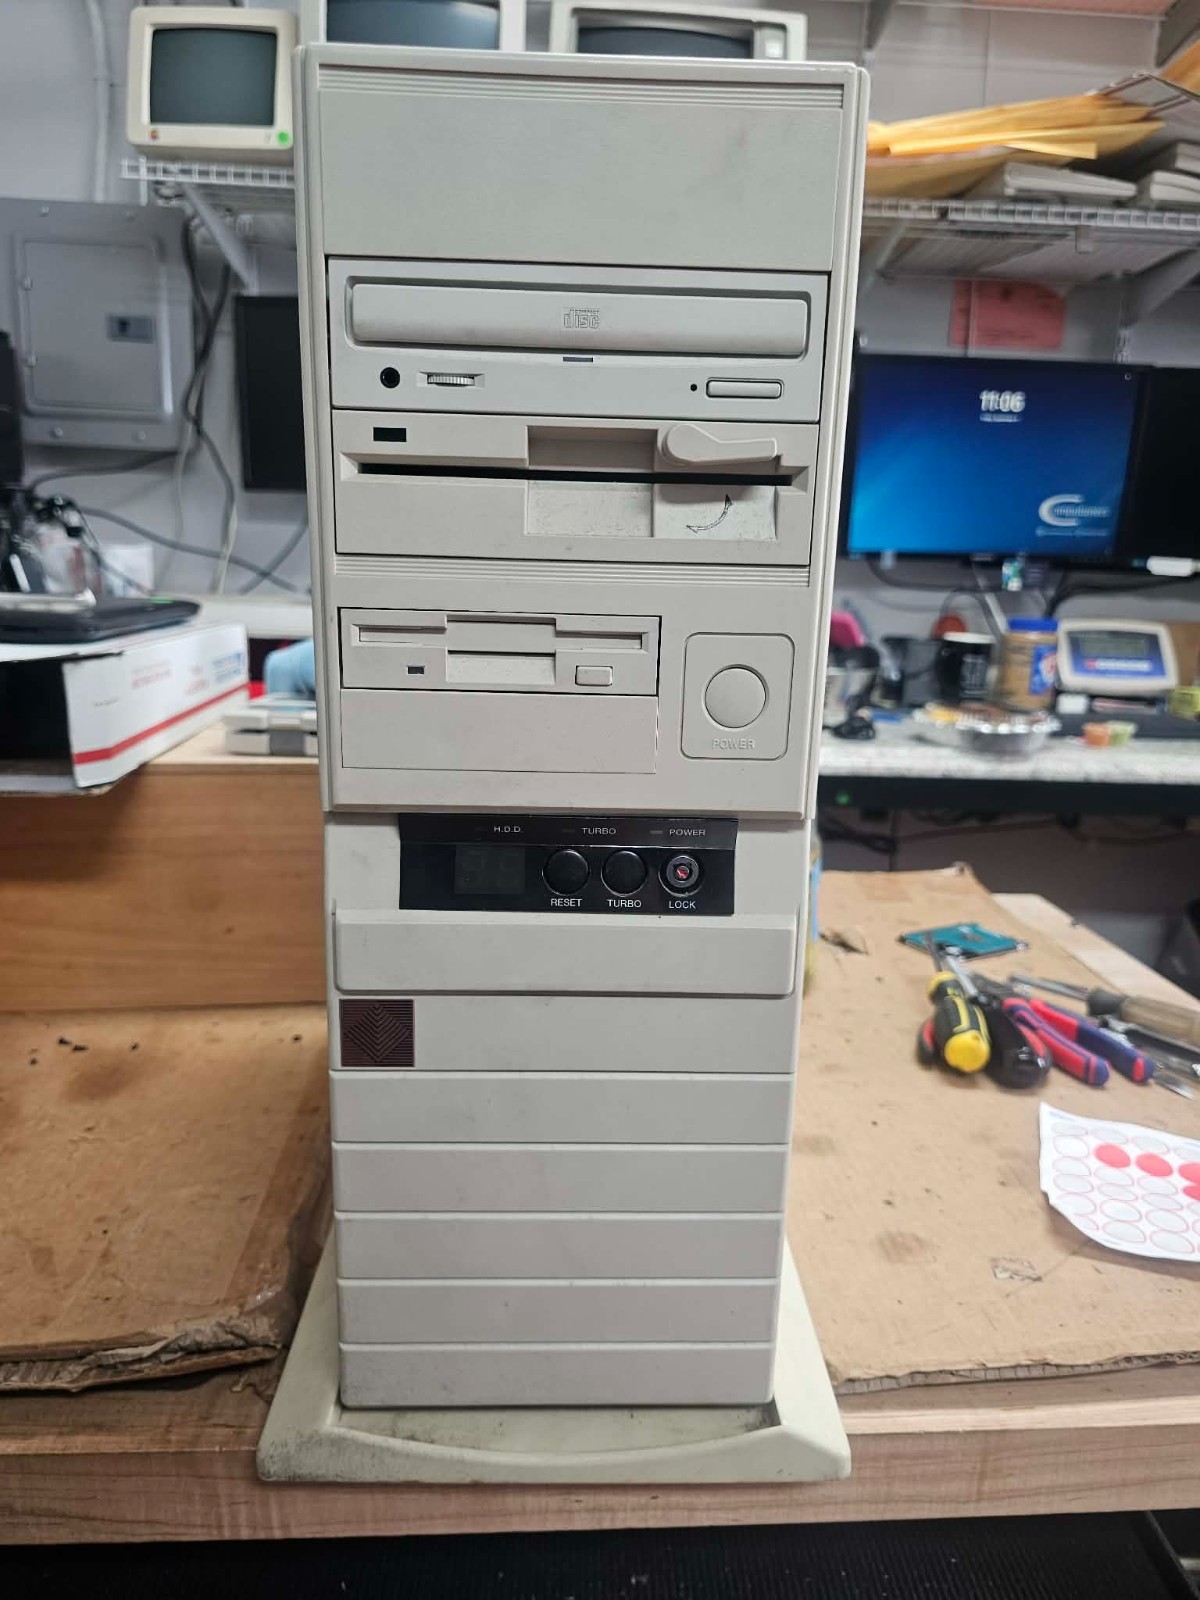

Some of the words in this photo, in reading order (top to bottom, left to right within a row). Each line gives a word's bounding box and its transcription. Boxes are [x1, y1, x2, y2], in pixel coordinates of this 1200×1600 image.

[563, 309, 600, 329] disc
[979, 389, 1026, 412] 11:06
[712, 738, 755, 750] POWER
[581, 827, 617, 835] TURBO
[669, 828, 706, 836] POWER
[550, 898, 583, 907] RESET
[607, 899, 642, 908] TURBO
[668, 900, 696, 909] LOCK
